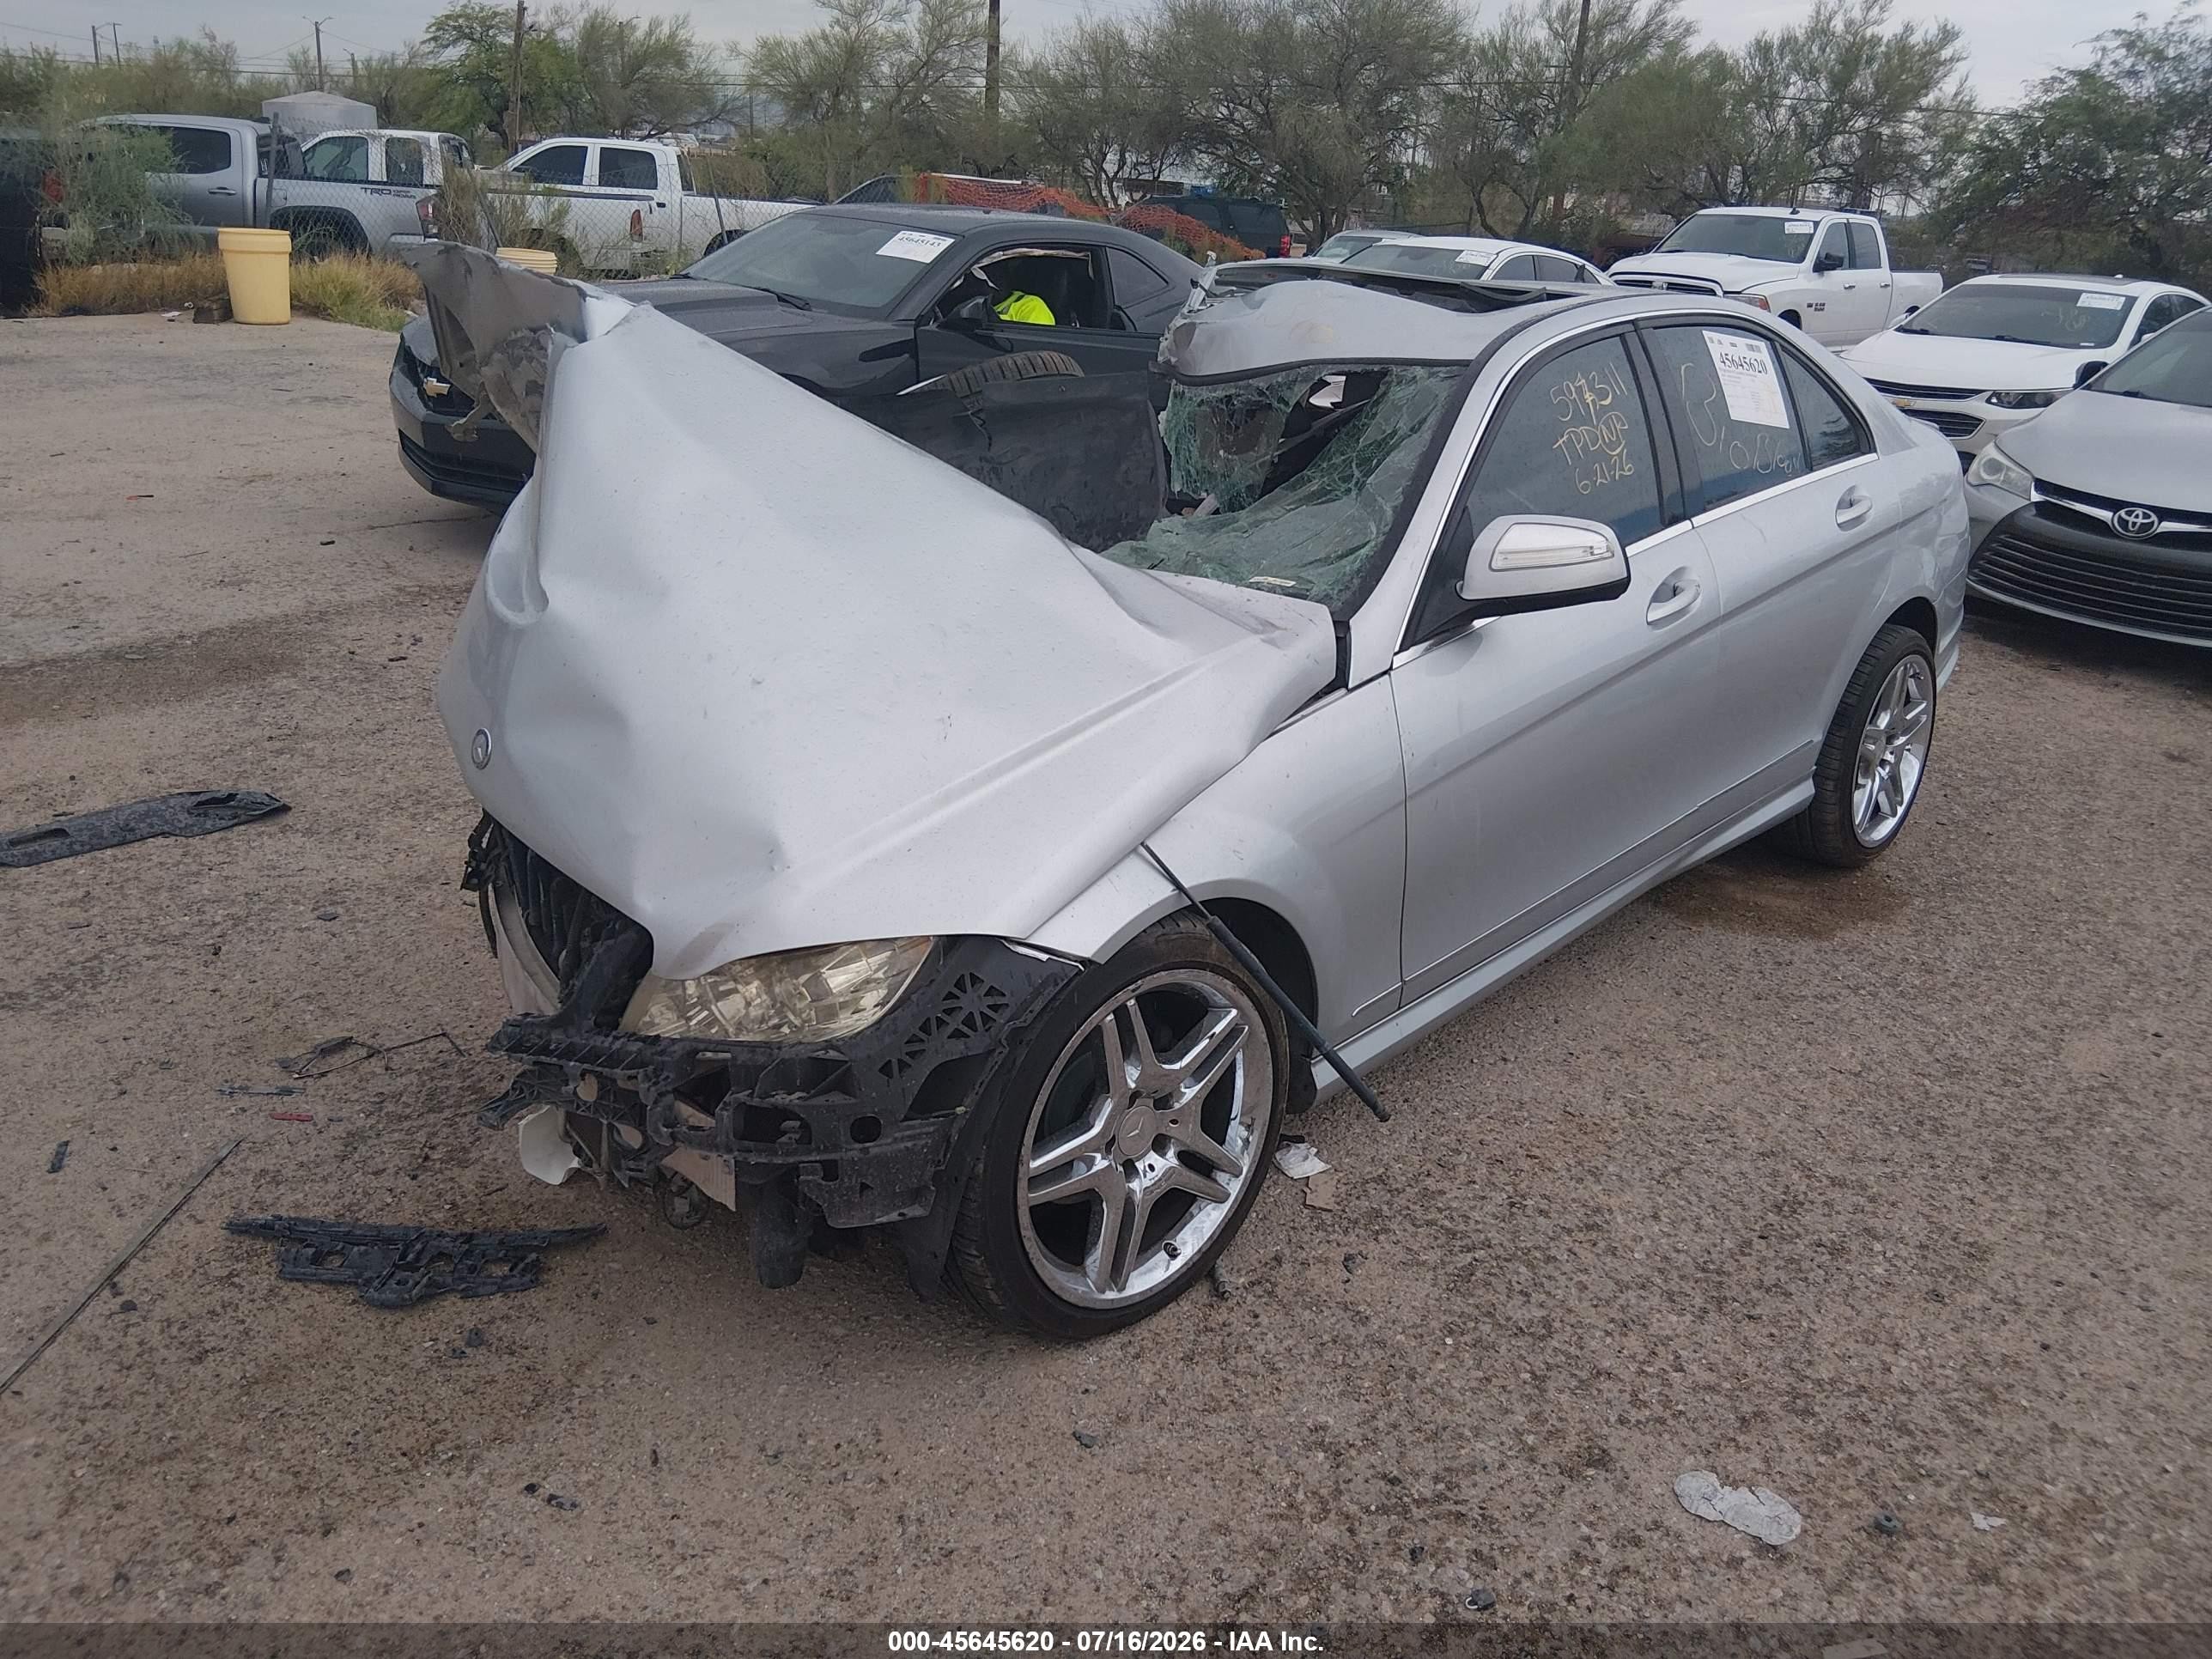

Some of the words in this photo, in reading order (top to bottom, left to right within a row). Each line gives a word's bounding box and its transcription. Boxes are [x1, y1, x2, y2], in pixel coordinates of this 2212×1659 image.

[360, 186, 392, 197] TRD
[898, 236, 941, 246] 45645143
[1719, 351, 1768, 375] 45645620
